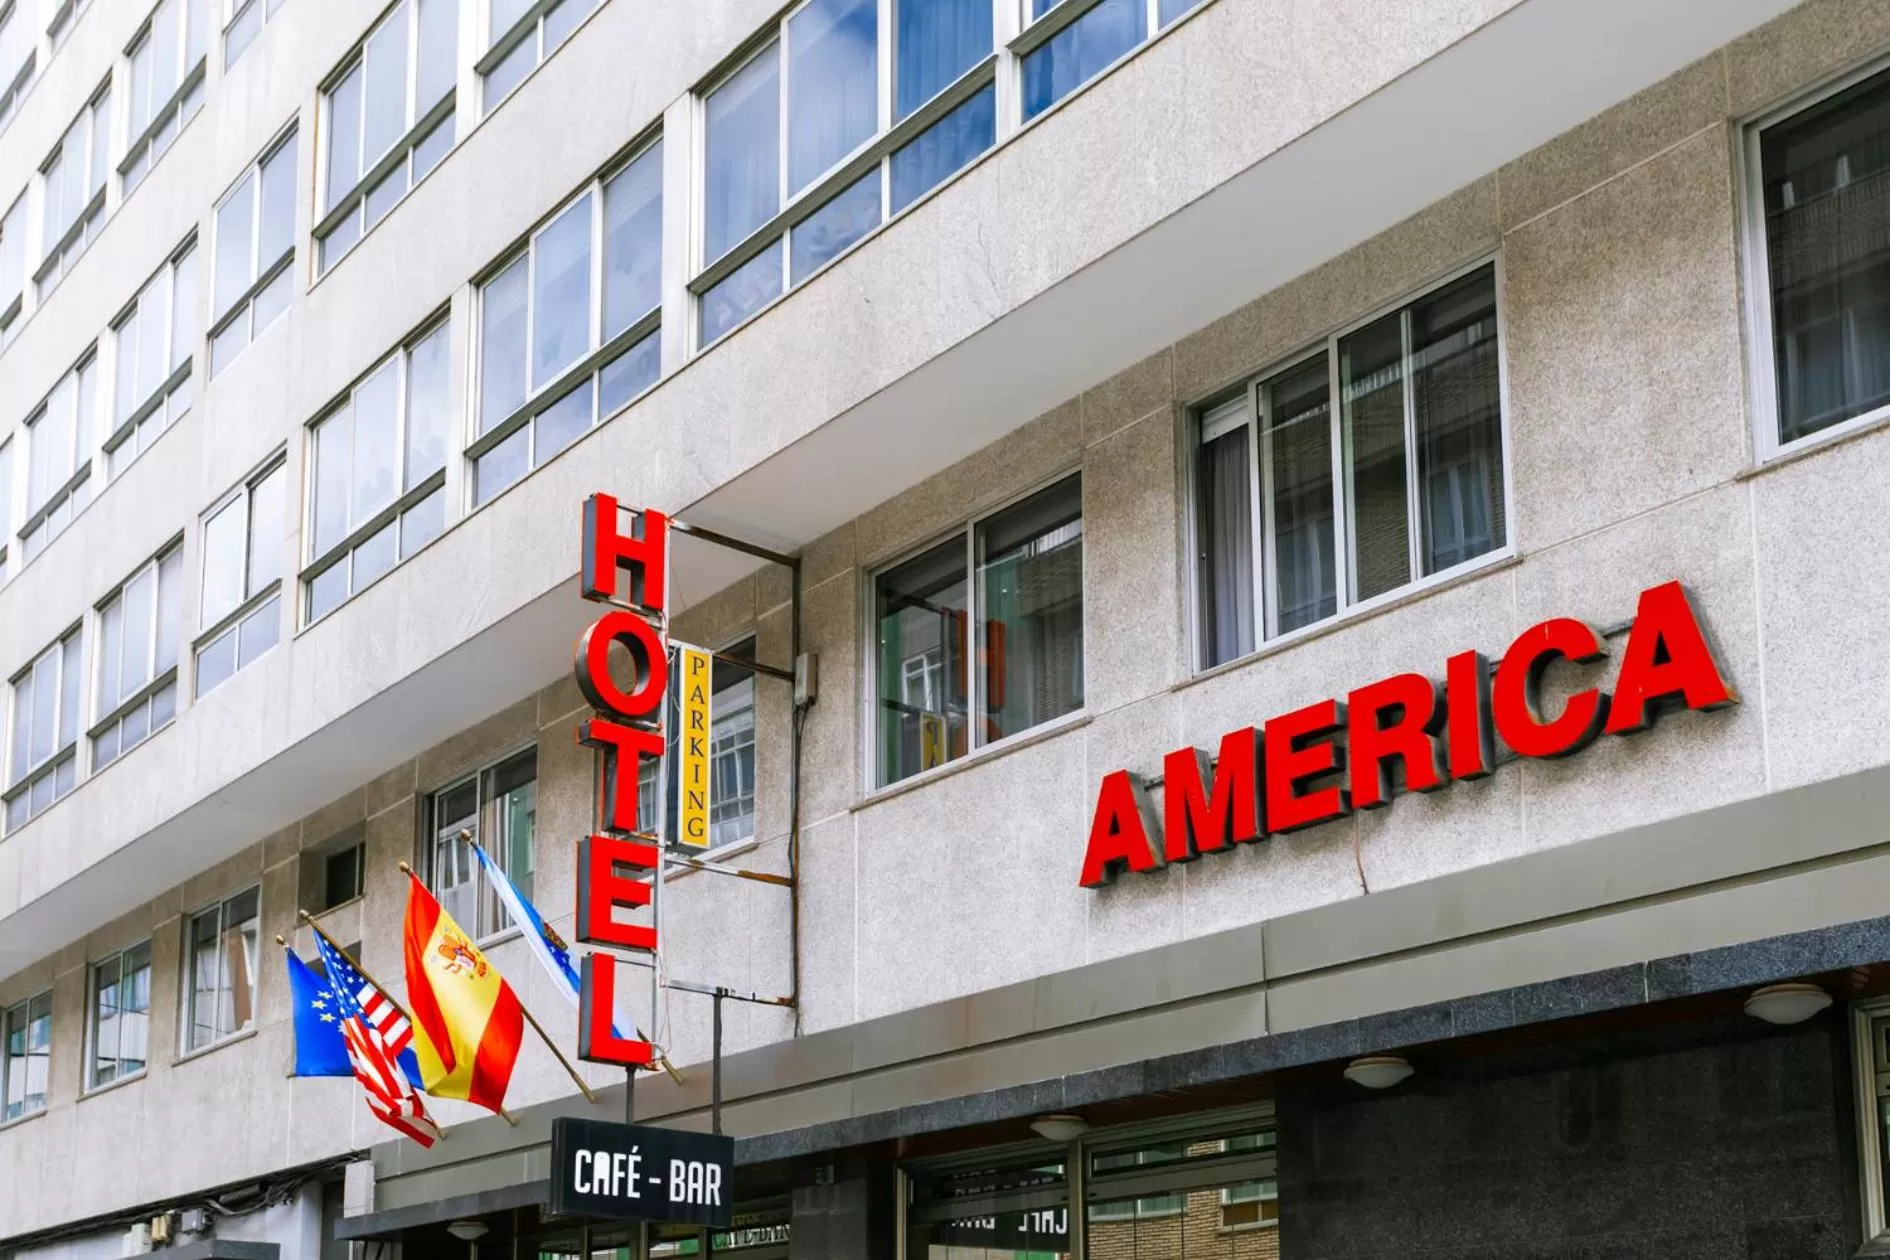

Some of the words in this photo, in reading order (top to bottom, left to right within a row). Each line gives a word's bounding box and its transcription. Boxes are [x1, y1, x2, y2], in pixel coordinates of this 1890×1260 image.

[577, 491, 669, 1066] HOTEL
[687, 655, 706, 839] PARKING
[1079, 580, 1737, 888] AMERICA
[574, 1145, 642, 1199] CAFÉ
[669, 1159, 722, 1206] BAR
